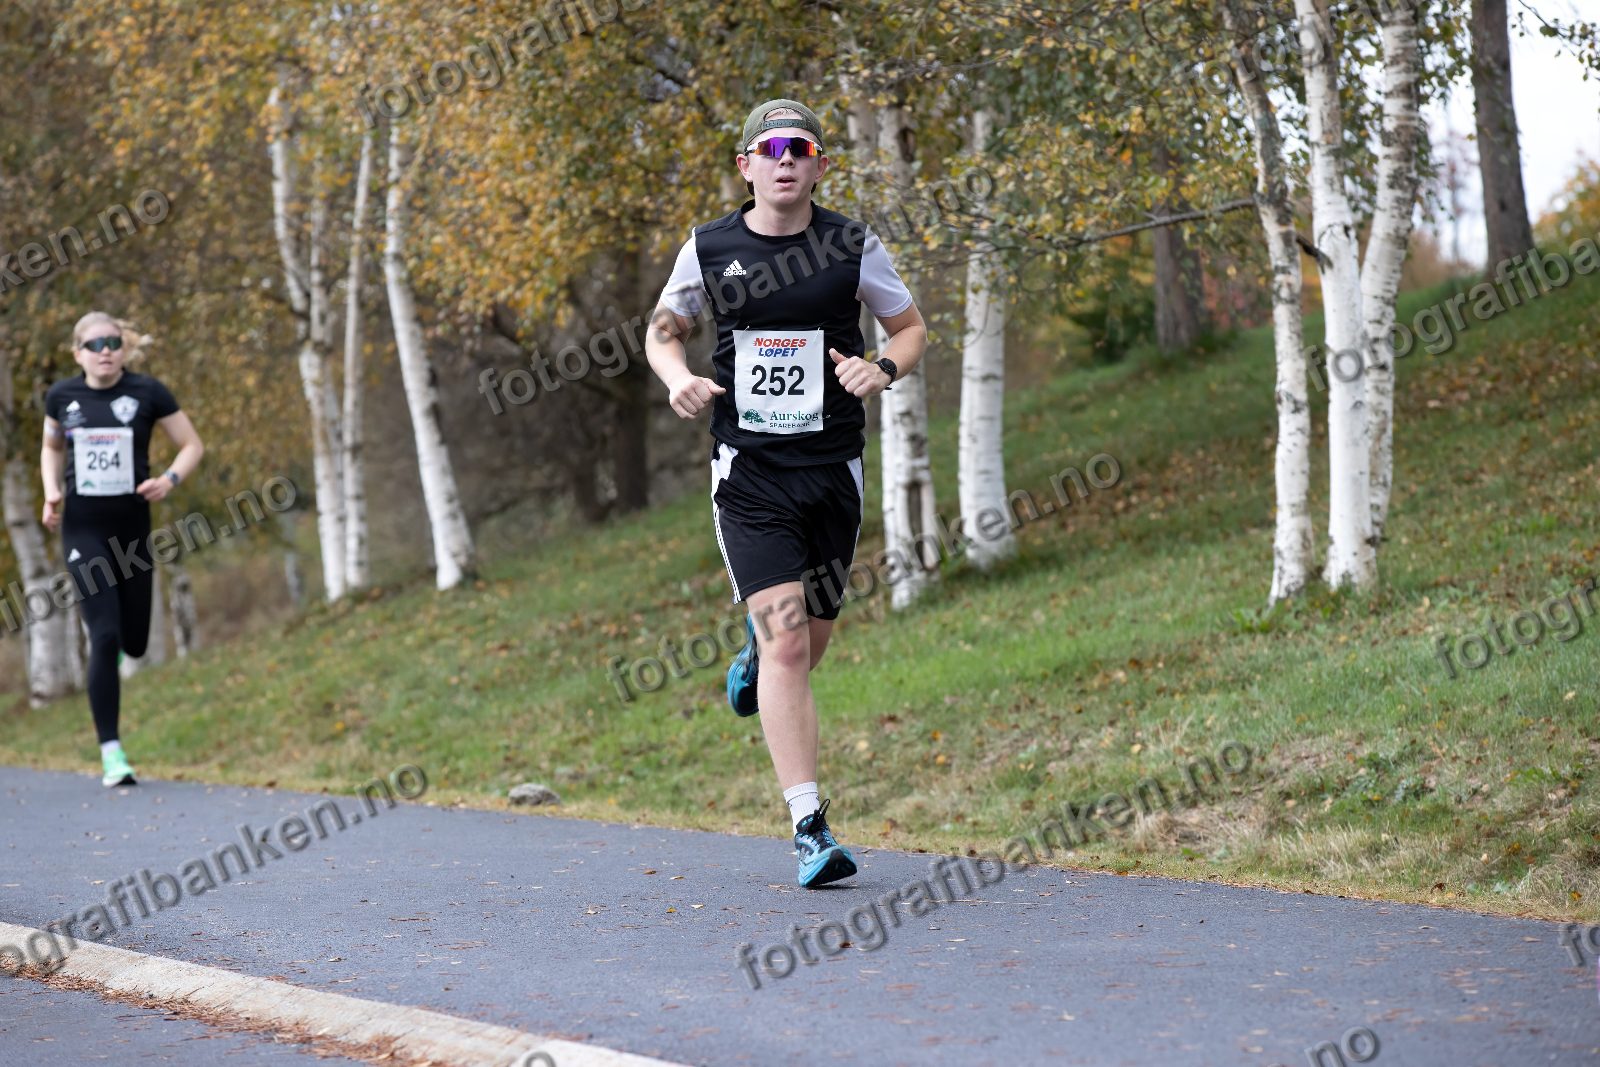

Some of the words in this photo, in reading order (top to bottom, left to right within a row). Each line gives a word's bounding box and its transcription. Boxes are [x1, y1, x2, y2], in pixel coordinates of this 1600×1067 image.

[723, 269, 747, 277] adidas
[754, 337, 807, 348] NORGES
[758, 347, 799, 358] LØPET
[751, 365, 805, 397] 252
[770, 410, 819, 422] Aurskog
[87, 450, 121, 471] 264
